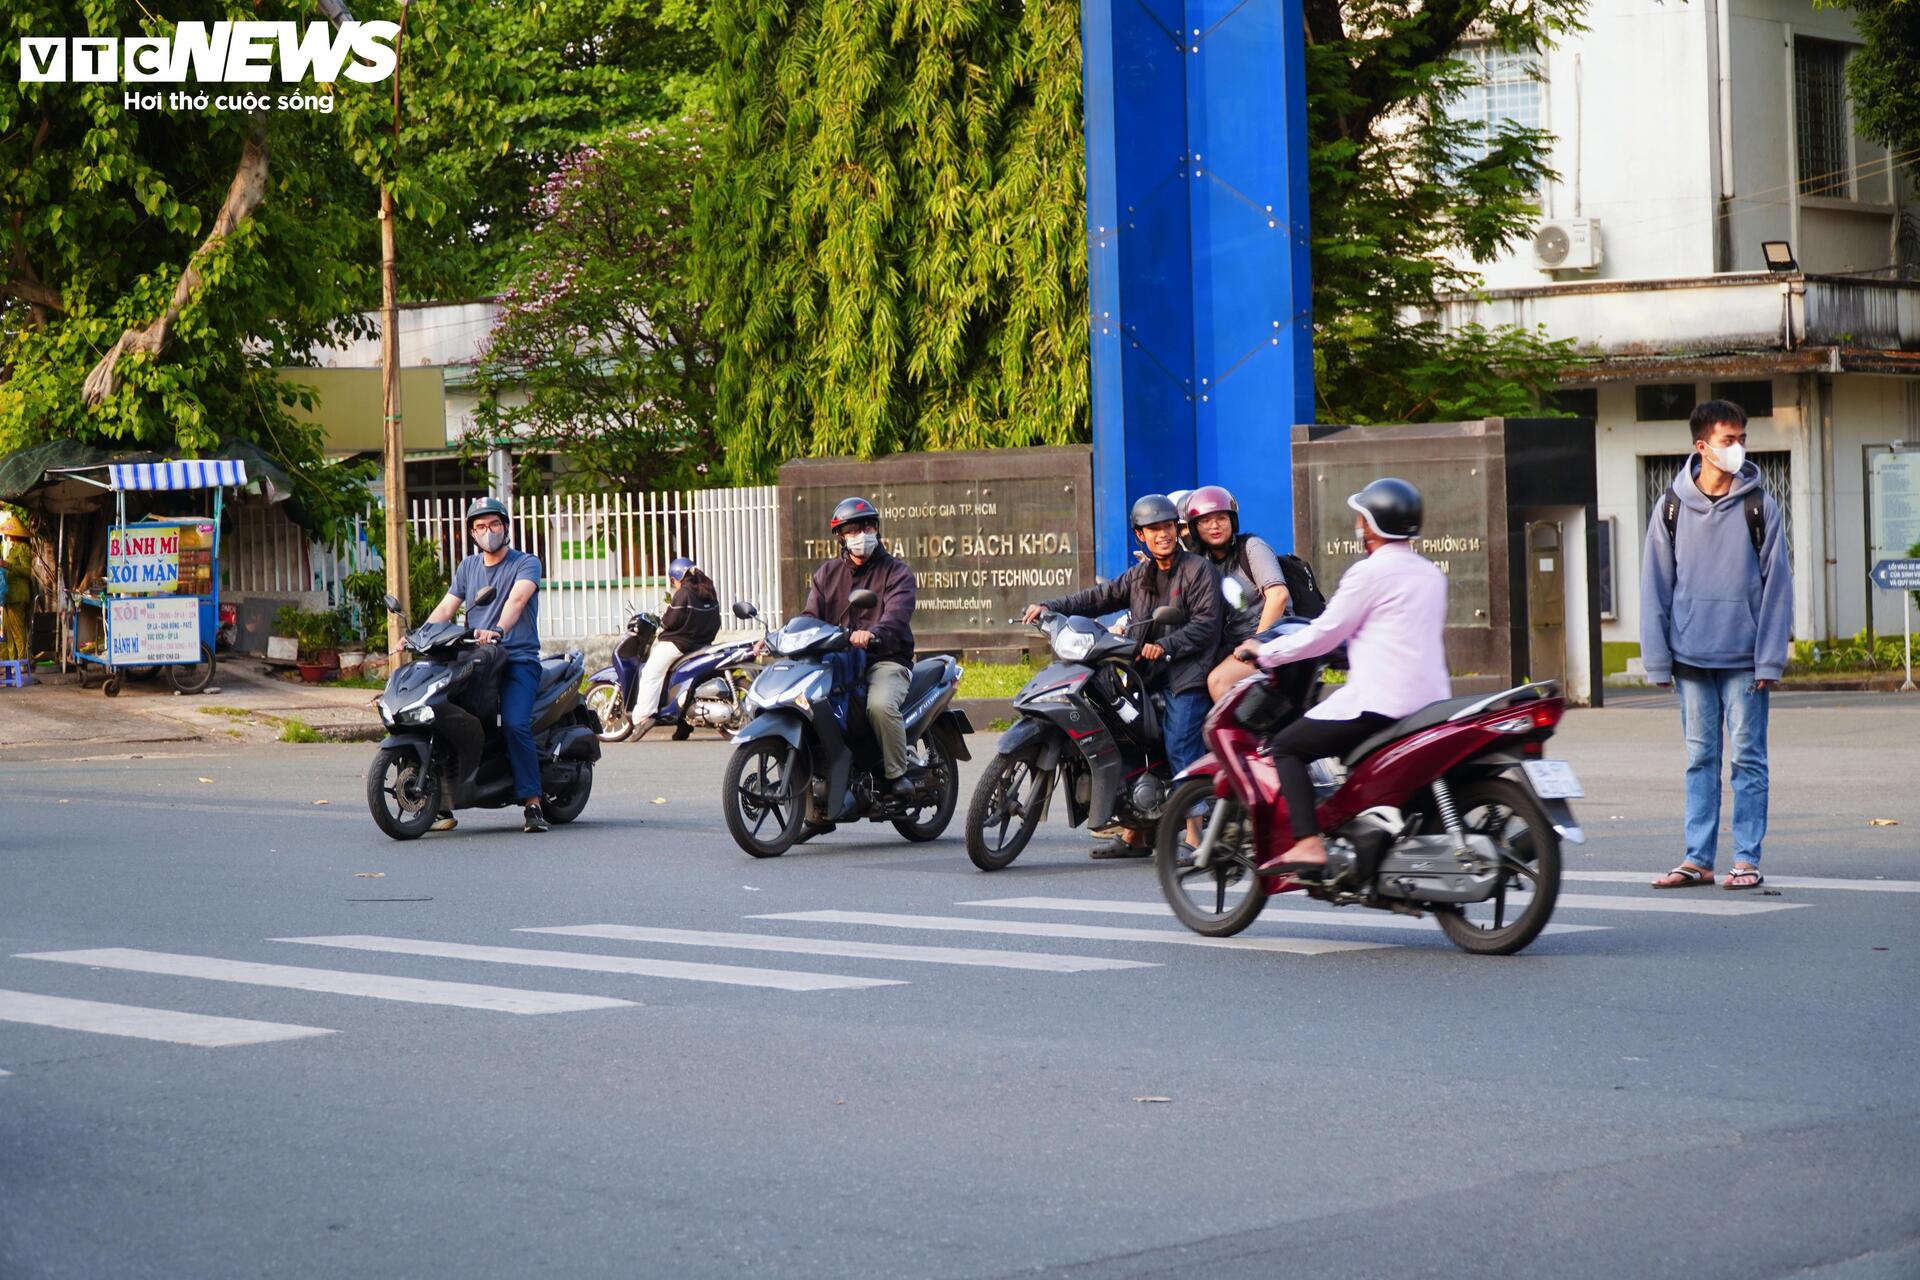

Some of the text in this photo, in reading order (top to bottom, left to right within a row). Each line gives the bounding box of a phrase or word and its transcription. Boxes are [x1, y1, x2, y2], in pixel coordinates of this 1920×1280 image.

[884, 506, 906, 522] HỌC
[908, 501, 936, 518] QUỐC
[939, 504, 956, 517] GIA
[959, 503, 997, 516] TP.HCM
[110, 531, 179, 556] BÁNH MÌ
[918, 535, 955, 562] HỌC
[961, 527, 1014, 556] BÁCH
[1019, 532, 1072, 555] KHOA
[1327, 538, 1341, 555] LÝ
[1422, 534, 1467, 553] PHƯỜNG
[1468, 538, 1480, 551] 14
[110, 559, 178, 587] XÔI MẶN
[916, 568, 1073, 589] IVERSITY OF TECHNOLOGY
